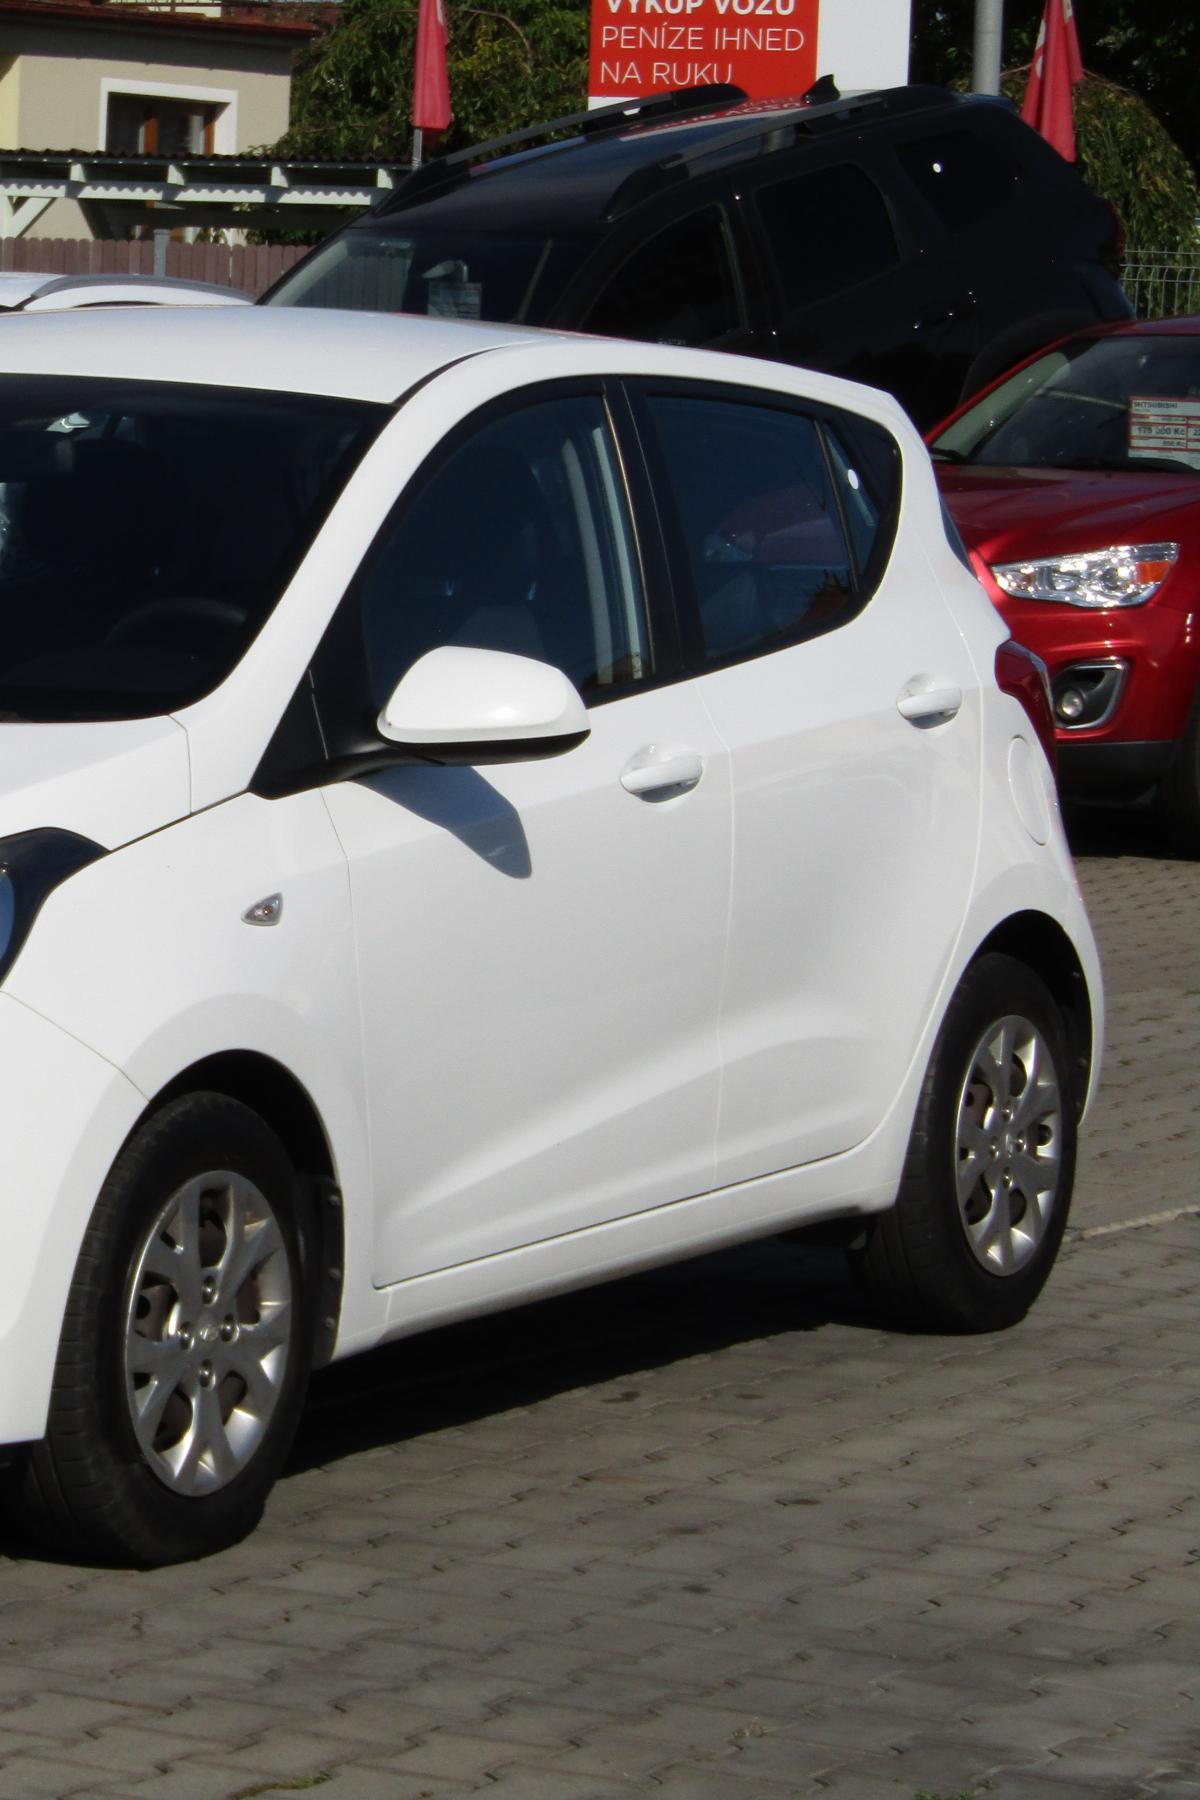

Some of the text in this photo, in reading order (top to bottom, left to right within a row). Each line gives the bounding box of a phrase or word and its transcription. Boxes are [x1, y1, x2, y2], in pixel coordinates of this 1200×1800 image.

[601, 22, 805, 51] PENÍZE IHNED
[600, 61, 732, 86] NA RUKU
